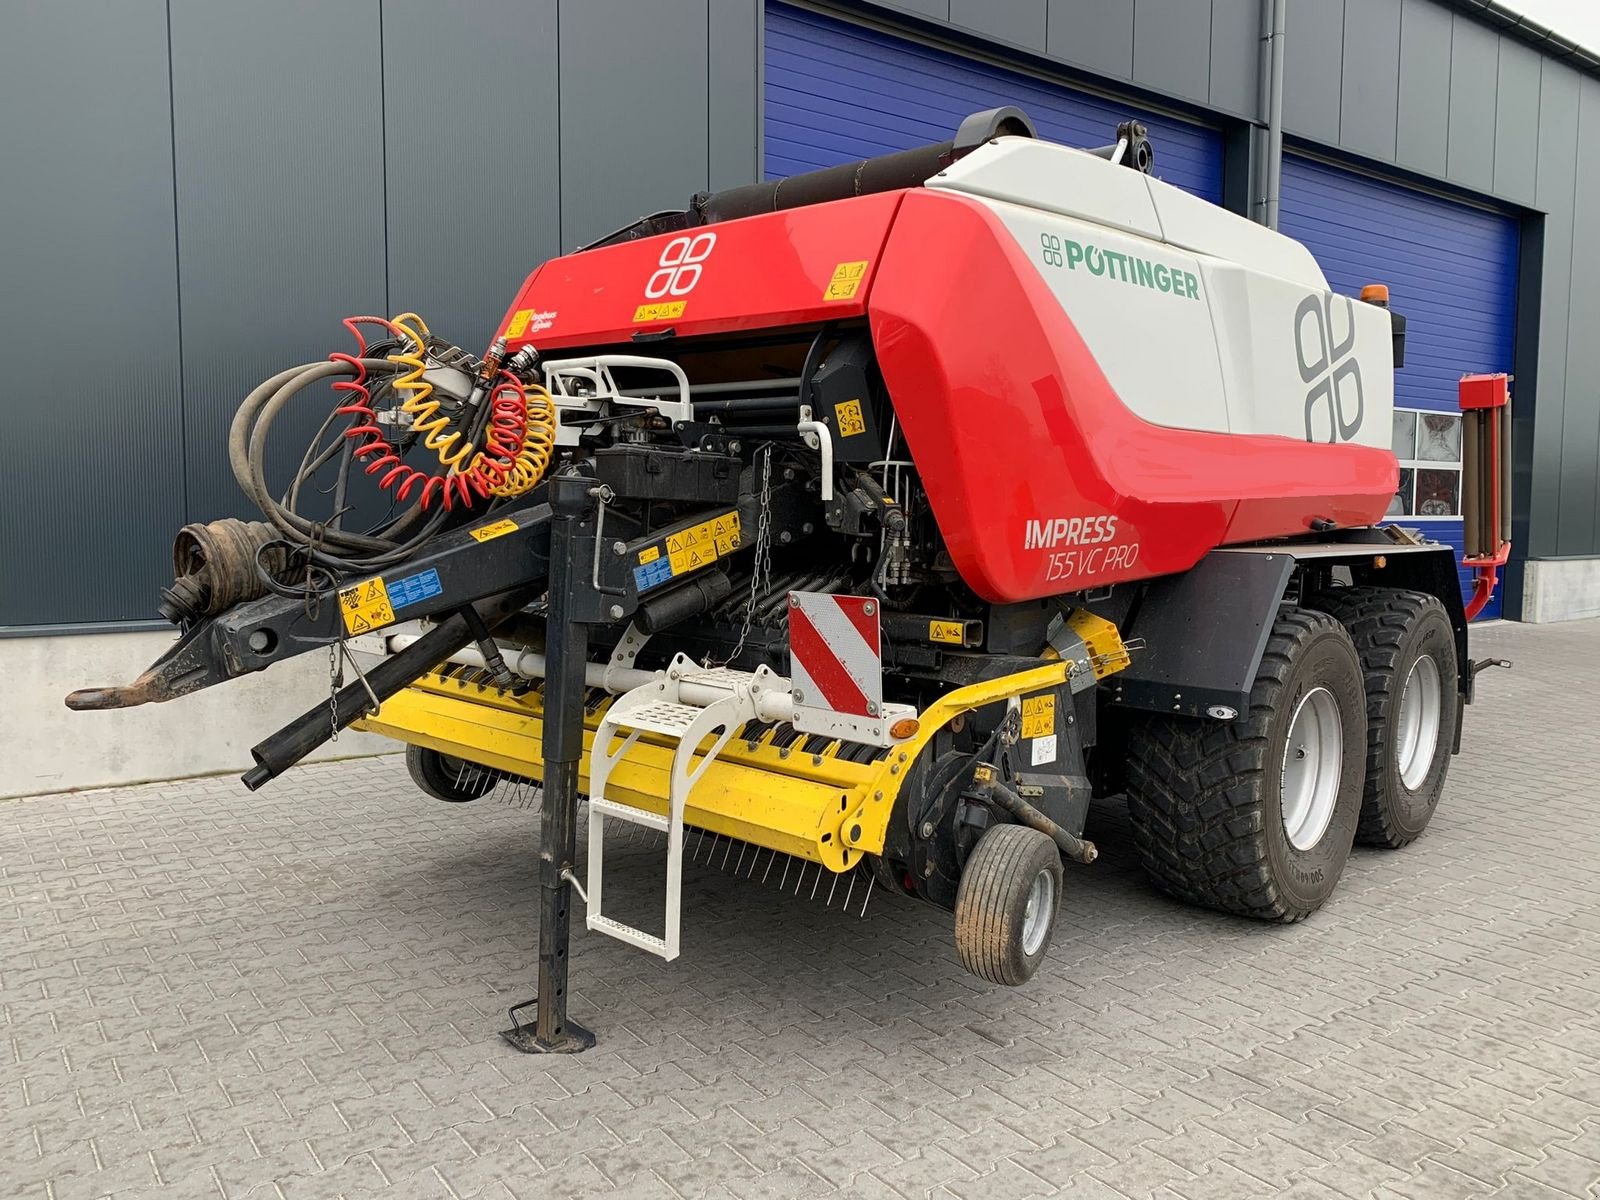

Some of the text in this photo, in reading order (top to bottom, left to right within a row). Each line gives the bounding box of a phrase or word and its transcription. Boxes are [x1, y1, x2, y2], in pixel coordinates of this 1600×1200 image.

[1064, 239, 1200, 301] PÖTTINGER
[1024, 515, 1118, 550] IMPRESS
[1046, 543, 1139, 581] 155 VC PRO
